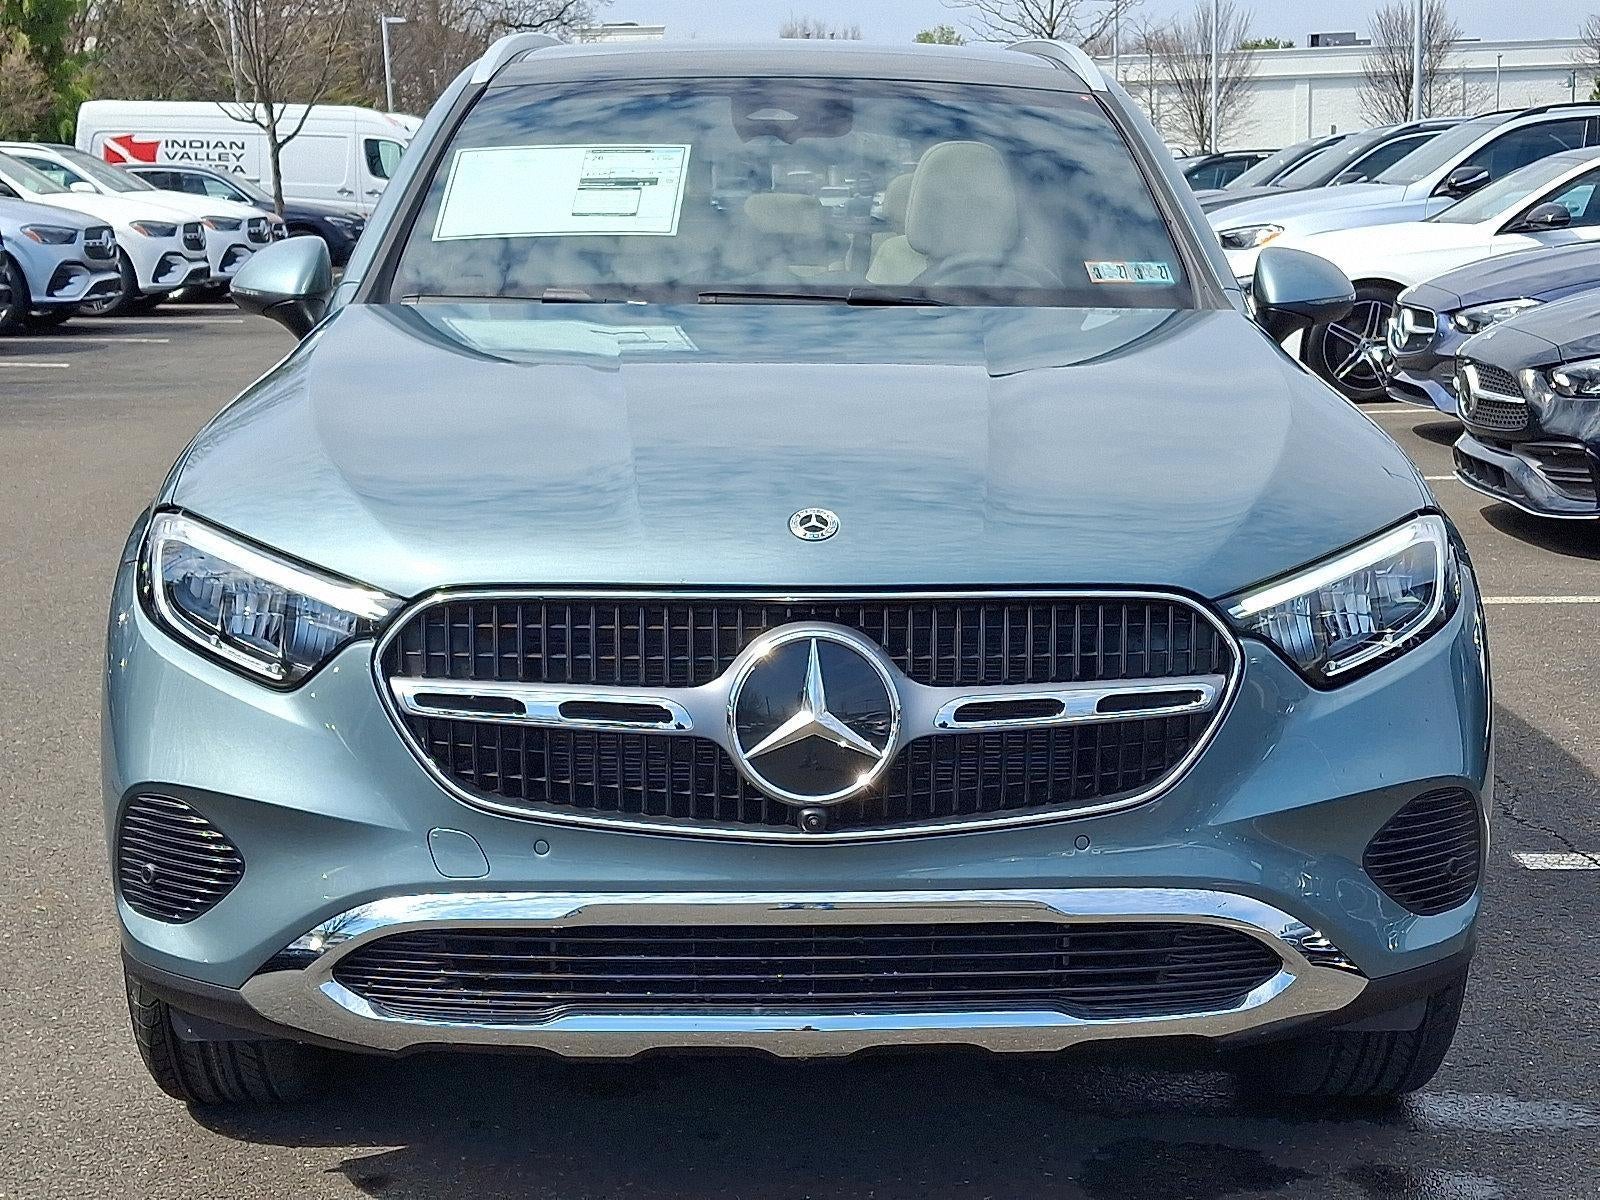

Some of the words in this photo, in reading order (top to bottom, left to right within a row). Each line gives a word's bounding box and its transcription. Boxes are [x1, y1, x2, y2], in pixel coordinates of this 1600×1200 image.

[164, 139, 246, 150] INDIAN
[164, 151, 245, 163] VALLEY
[1117, 265, 1129, 279] 27
[1157, 265, 1169, 280] 27
